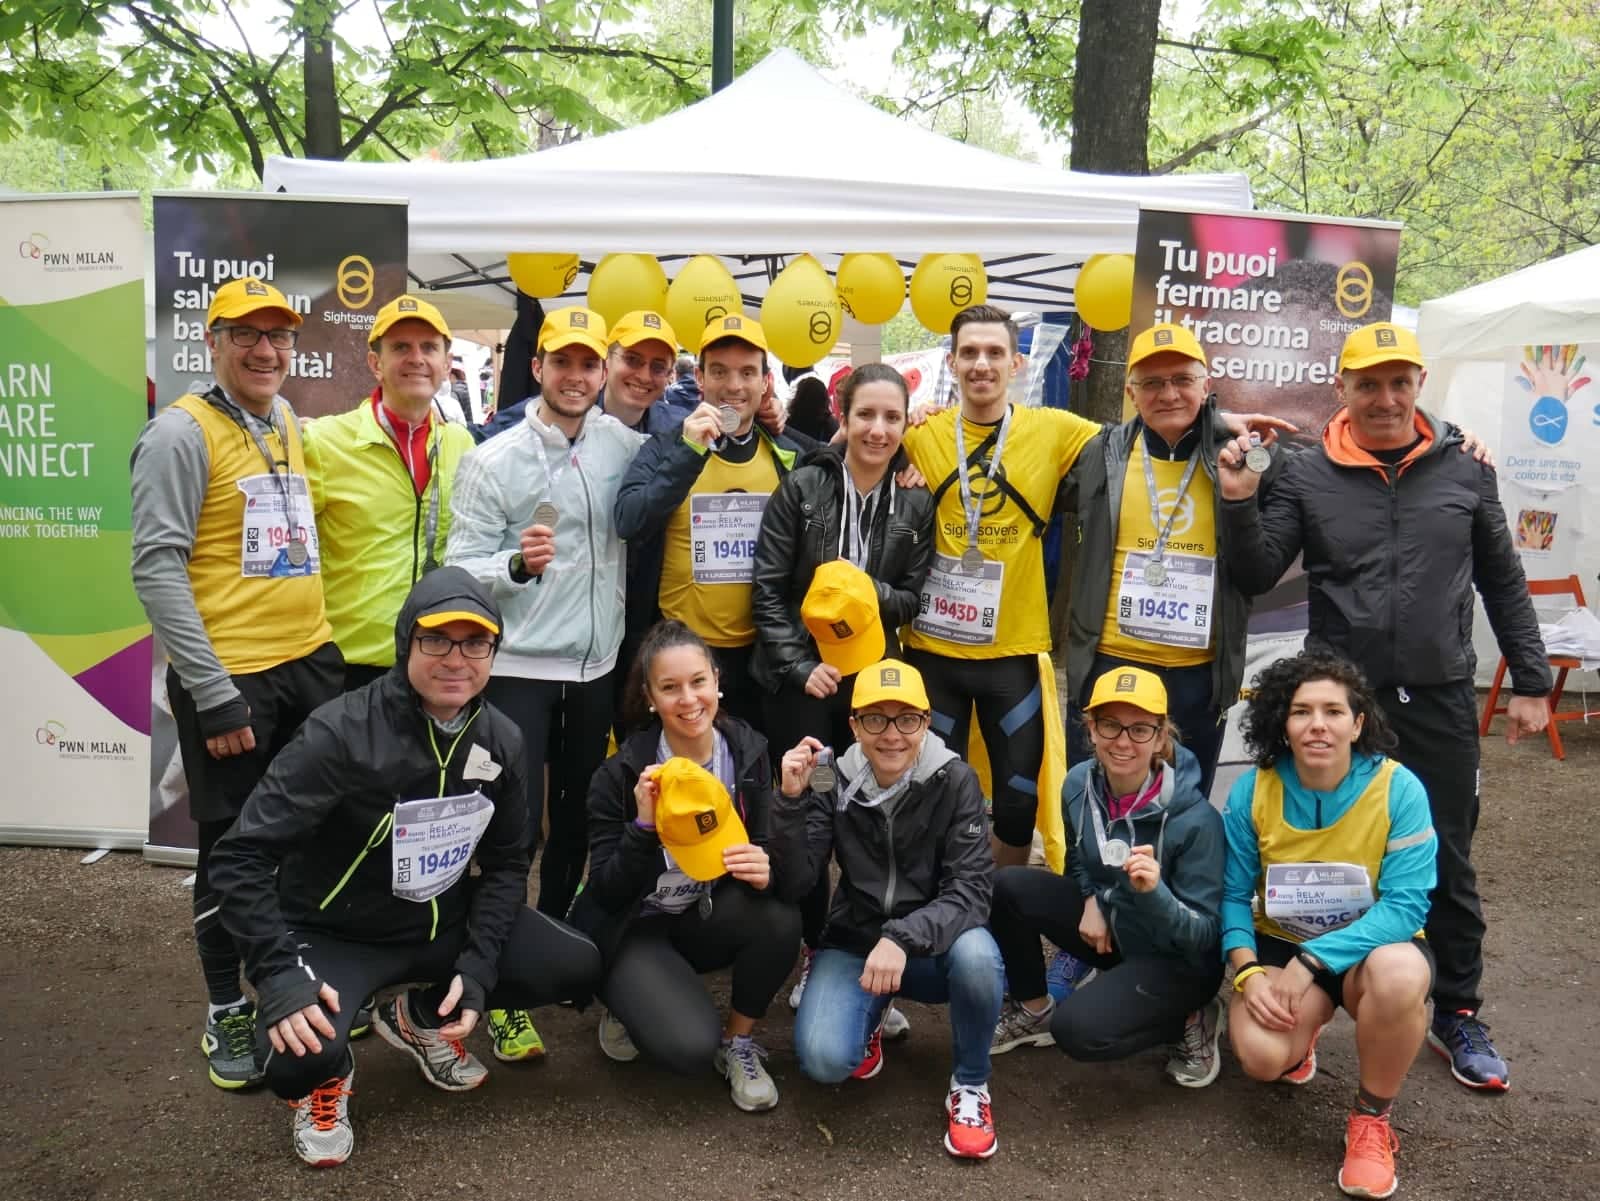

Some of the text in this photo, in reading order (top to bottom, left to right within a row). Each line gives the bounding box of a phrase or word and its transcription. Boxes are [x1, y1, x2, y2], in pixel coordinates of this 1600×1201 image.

[43, 252, 114, 265] PWN MILAN
[173, 251, 274, 284] Tu puoi
[1159, 239, 1277, 279] Tu puoi
[1156, 276, 1282, 312] fermare
[1180, 313, 1310, 349] tracoma
[1210, 355, 1338, 388] sempre!
[50, 507, 73, 521] THE
[77, 507, 103, 520] WAY
[36, 525, 99, 538] TOGETHER
[944, 522, 1019, 538] Sighsavers
[713, 540, 758, 559] 1941B
[934, 596, 978, 622] 1943D
[1138, 598, 1190, 621] 1943C
[418, 842, 471, 876] 1942B
